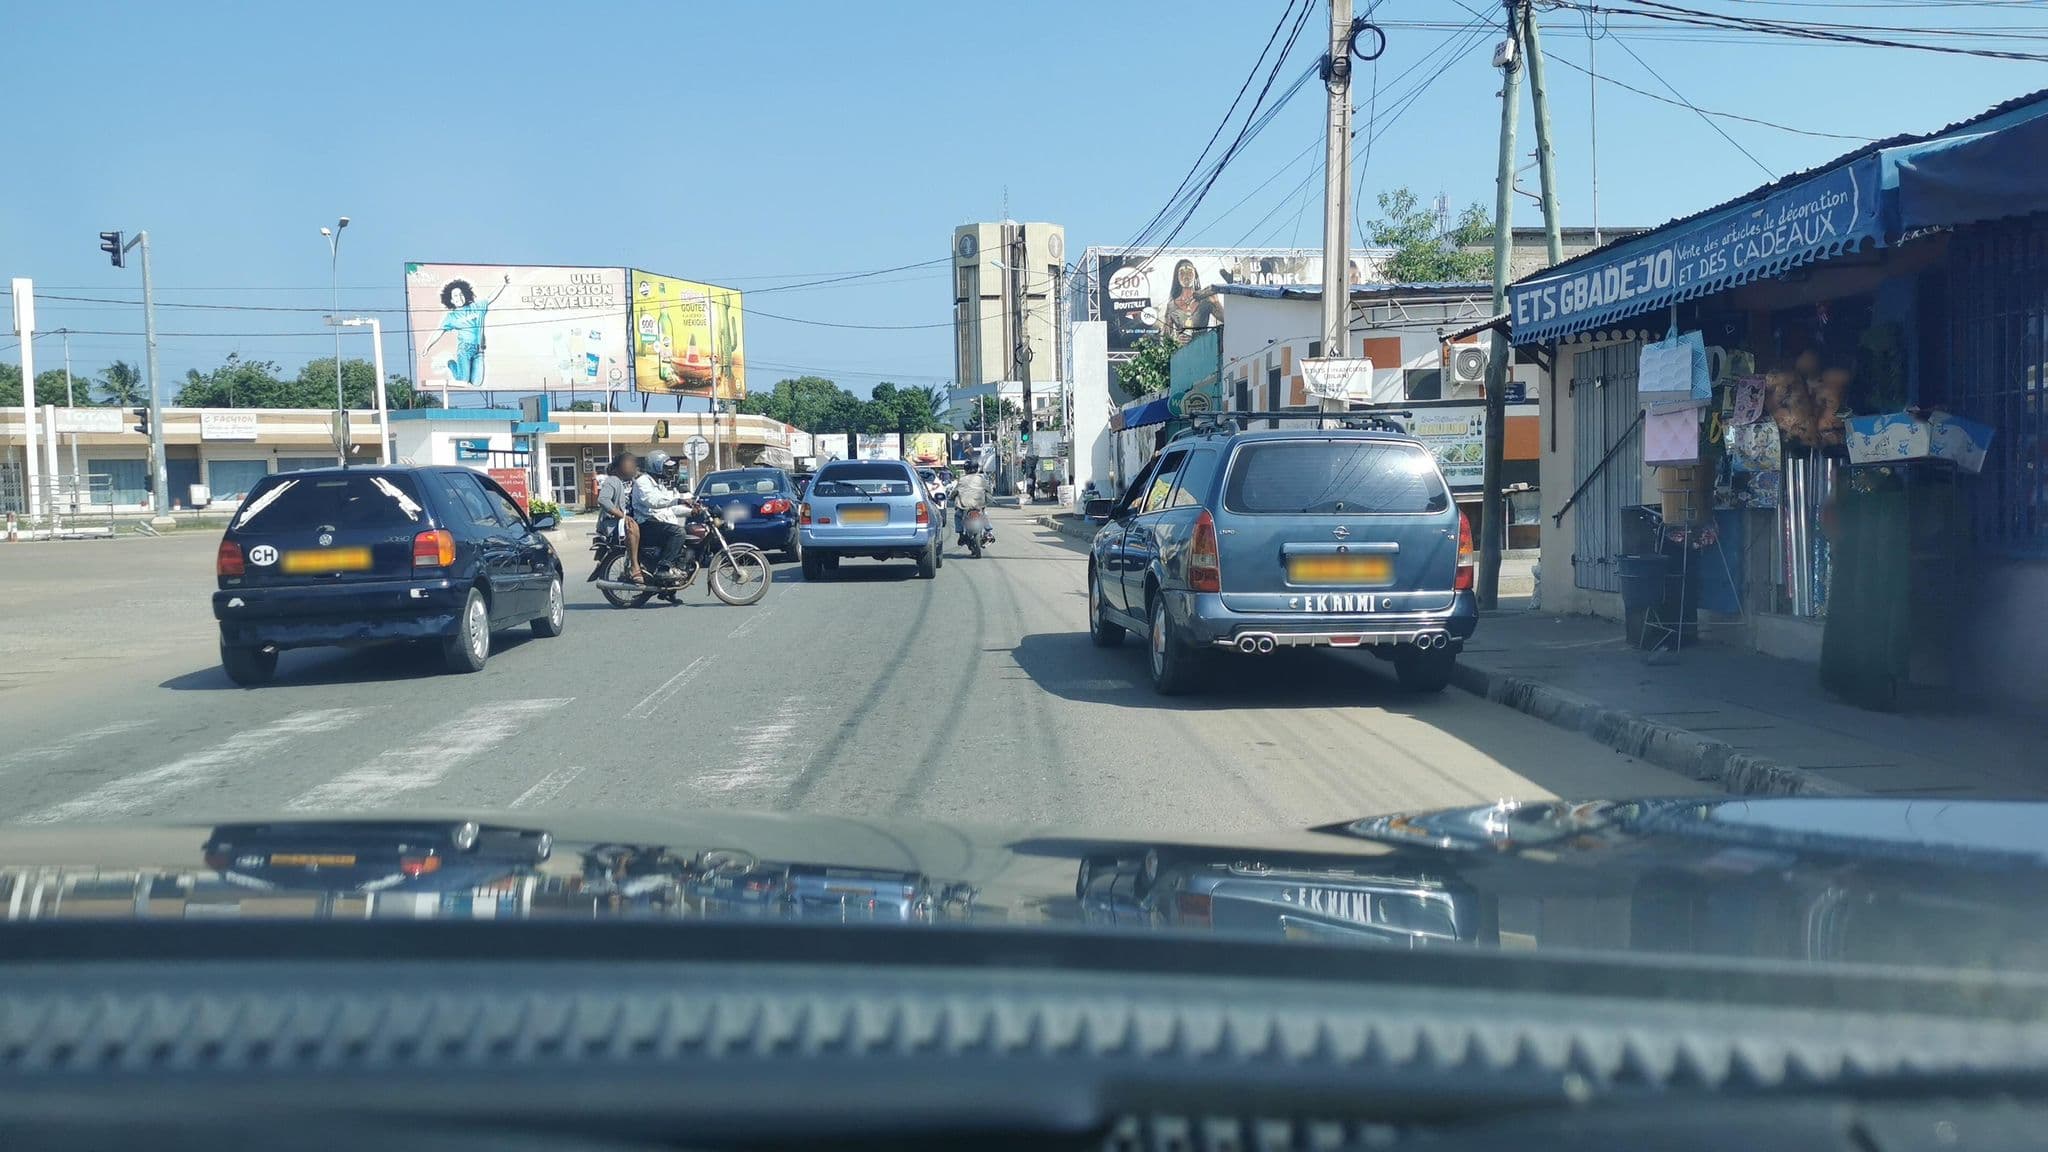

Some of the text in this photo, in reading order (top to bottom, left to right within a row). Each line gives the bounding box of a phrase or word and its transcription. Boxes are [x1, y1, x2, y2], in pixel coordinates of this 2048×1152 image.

[1704, 235, 1719, 253] des
[1722, 222, 1761, 246] articles
[1763, 213, 1774, 231] de
[1778, 190, 1848, 226] décoration
[1679, 210, 1837, 286] ET DES CADEAUX
[570, 273, 601, 285] UNE
[530, 284, 614, 296] EXPLOSION
[1517, 249, 1672, 325] ETS GBADEJO
[533, 296, 614, 310] SAVEURS
[252, 549, 274, 562] CH
